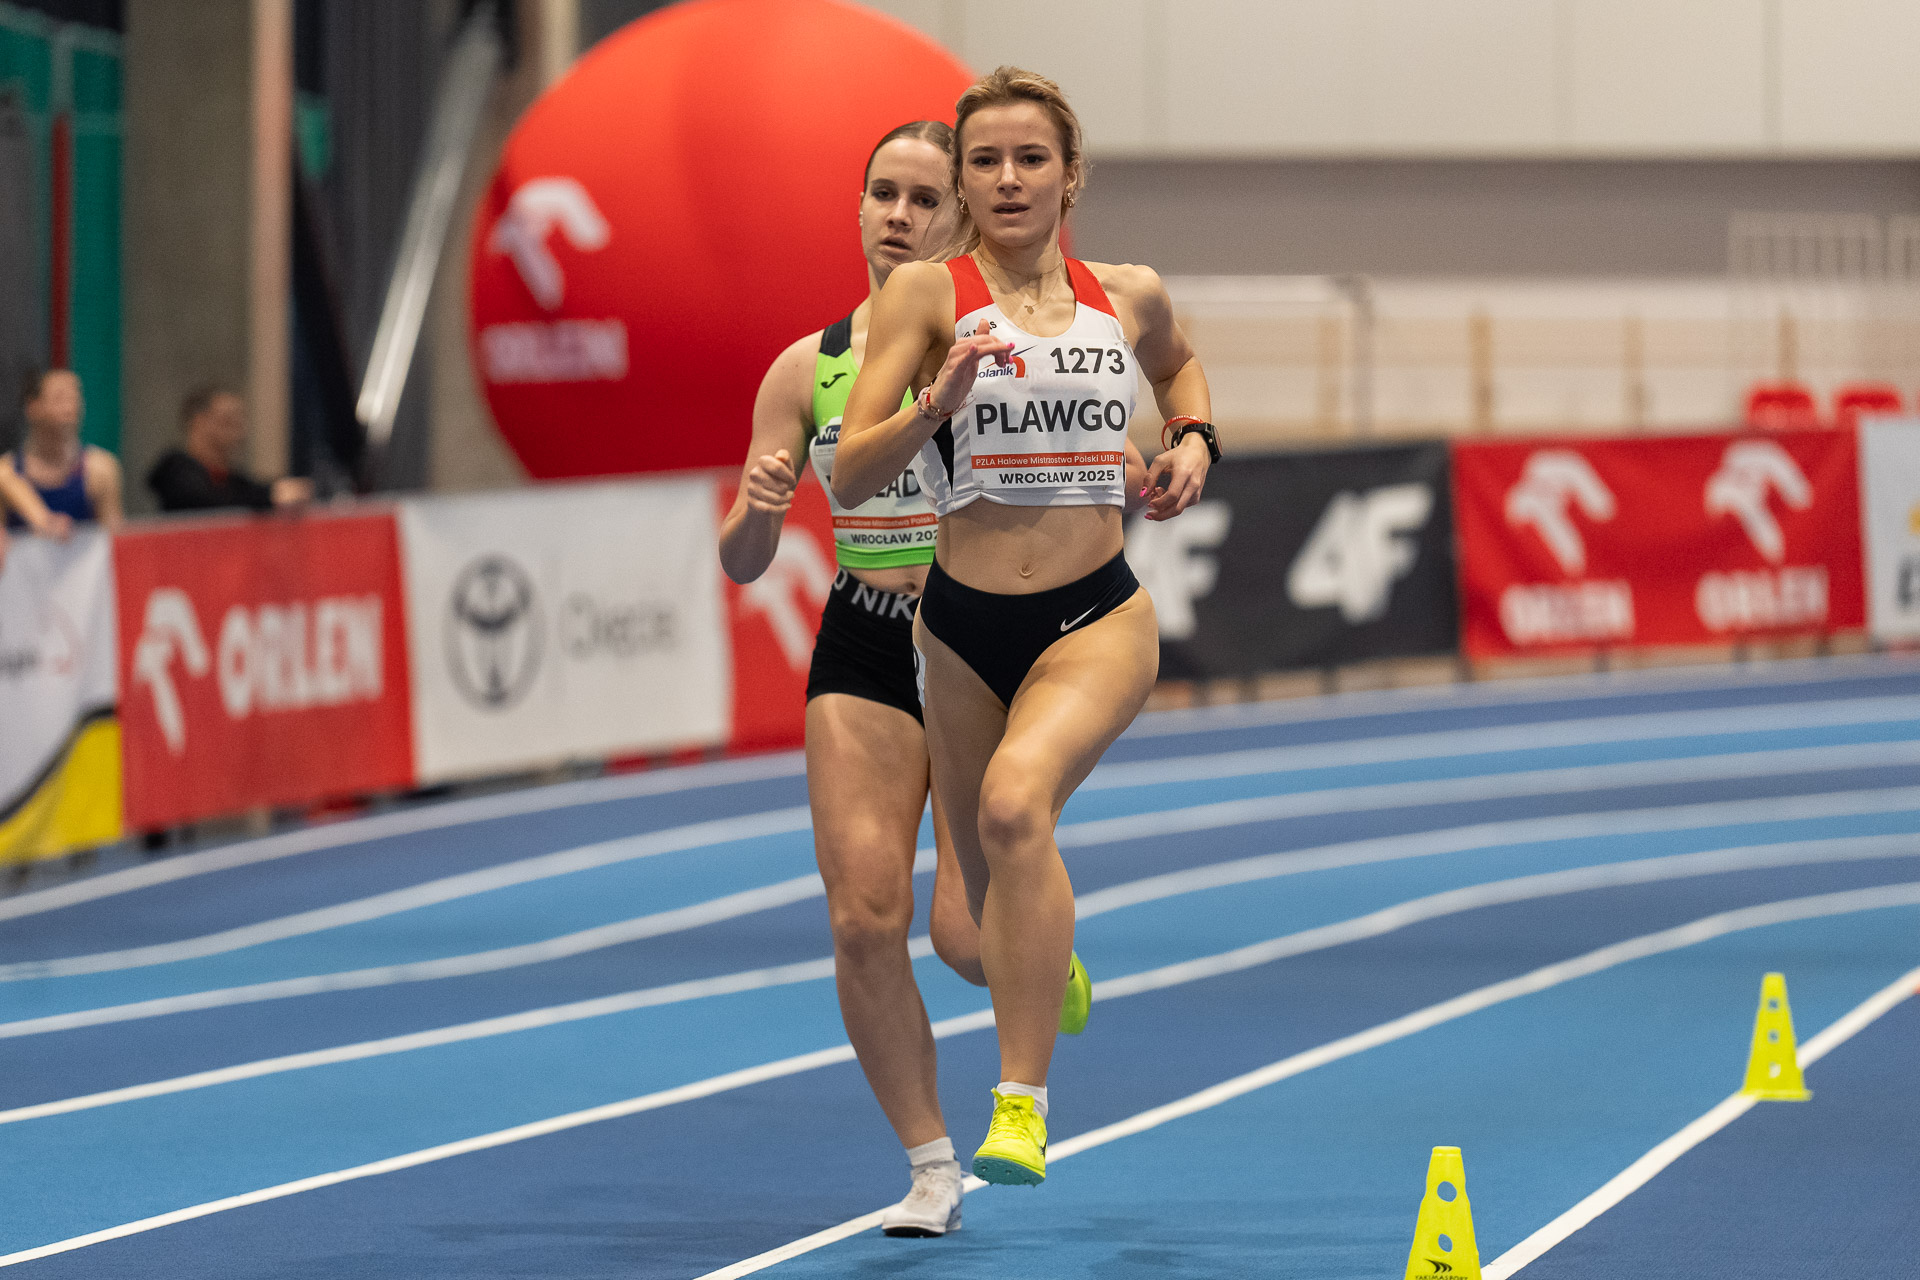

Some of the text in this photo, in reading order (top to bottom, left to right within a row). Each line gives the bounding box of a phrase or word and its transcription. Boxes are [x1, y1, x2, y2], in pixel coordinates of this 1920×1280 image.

[1050, 347, 1125, 375] 1273
[977, 366, 1014, 378] olanik
[975, 398, 1127, 435] PLAWGO
[975, 458, 996, 466] PZLA
[1030, 456, 1072, 465] Mistrzostwa
[1074, 454, 1099, 463] Polski
[1100, 454, 1115, 462] U18
[998, 470, 1116, 484] WROCŁAW 2025
[910, 515, 933, 525] Polski
[851, 533, 912, 545] WROCŁAW
[1286, 483, 1434, 624] 4F
